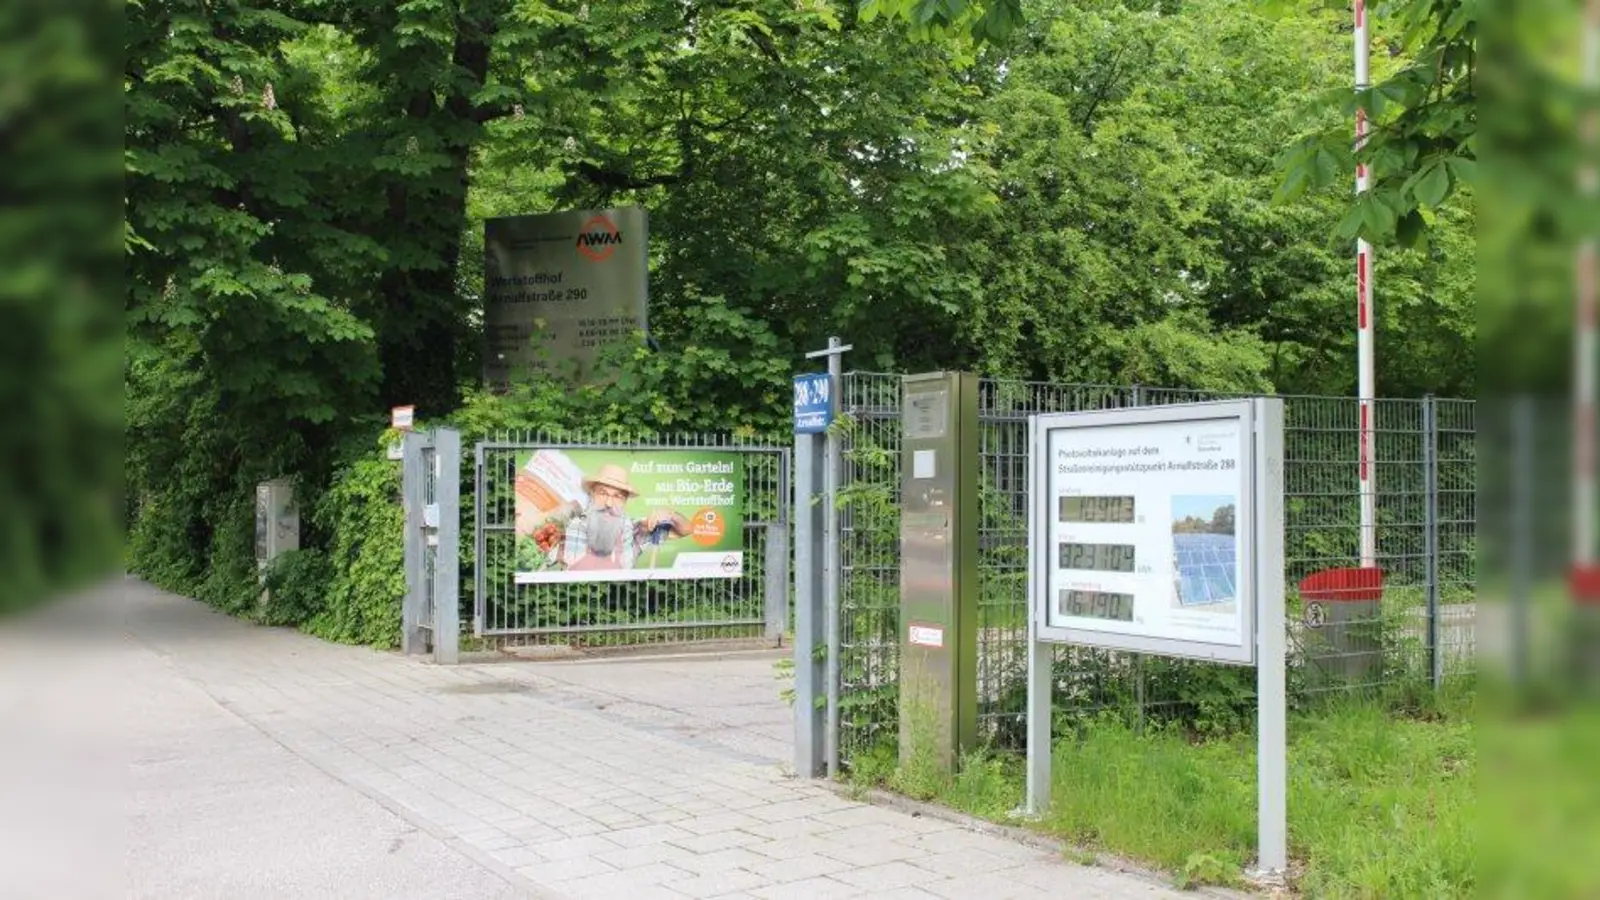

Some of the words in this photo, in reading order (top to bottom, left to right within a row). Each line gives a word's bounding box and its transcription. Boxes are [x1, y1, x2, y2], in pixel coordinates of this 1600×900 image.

[576, 231, 622, 247] AWM
[491, 272, 562, 288] Wertstoffhof
[491, 290, 563, 304] Arnulfstraße
[565, 288, 587, 300] 290
[1058, 446, 1127, 459] Photovoltaikanlage
[1128, 446, 1141, 456] auf
[1141, 446, 1159, 456] dem
[631, 461, 653, 473] Auf
[676, 478, 734, 492] Bio-Erde
